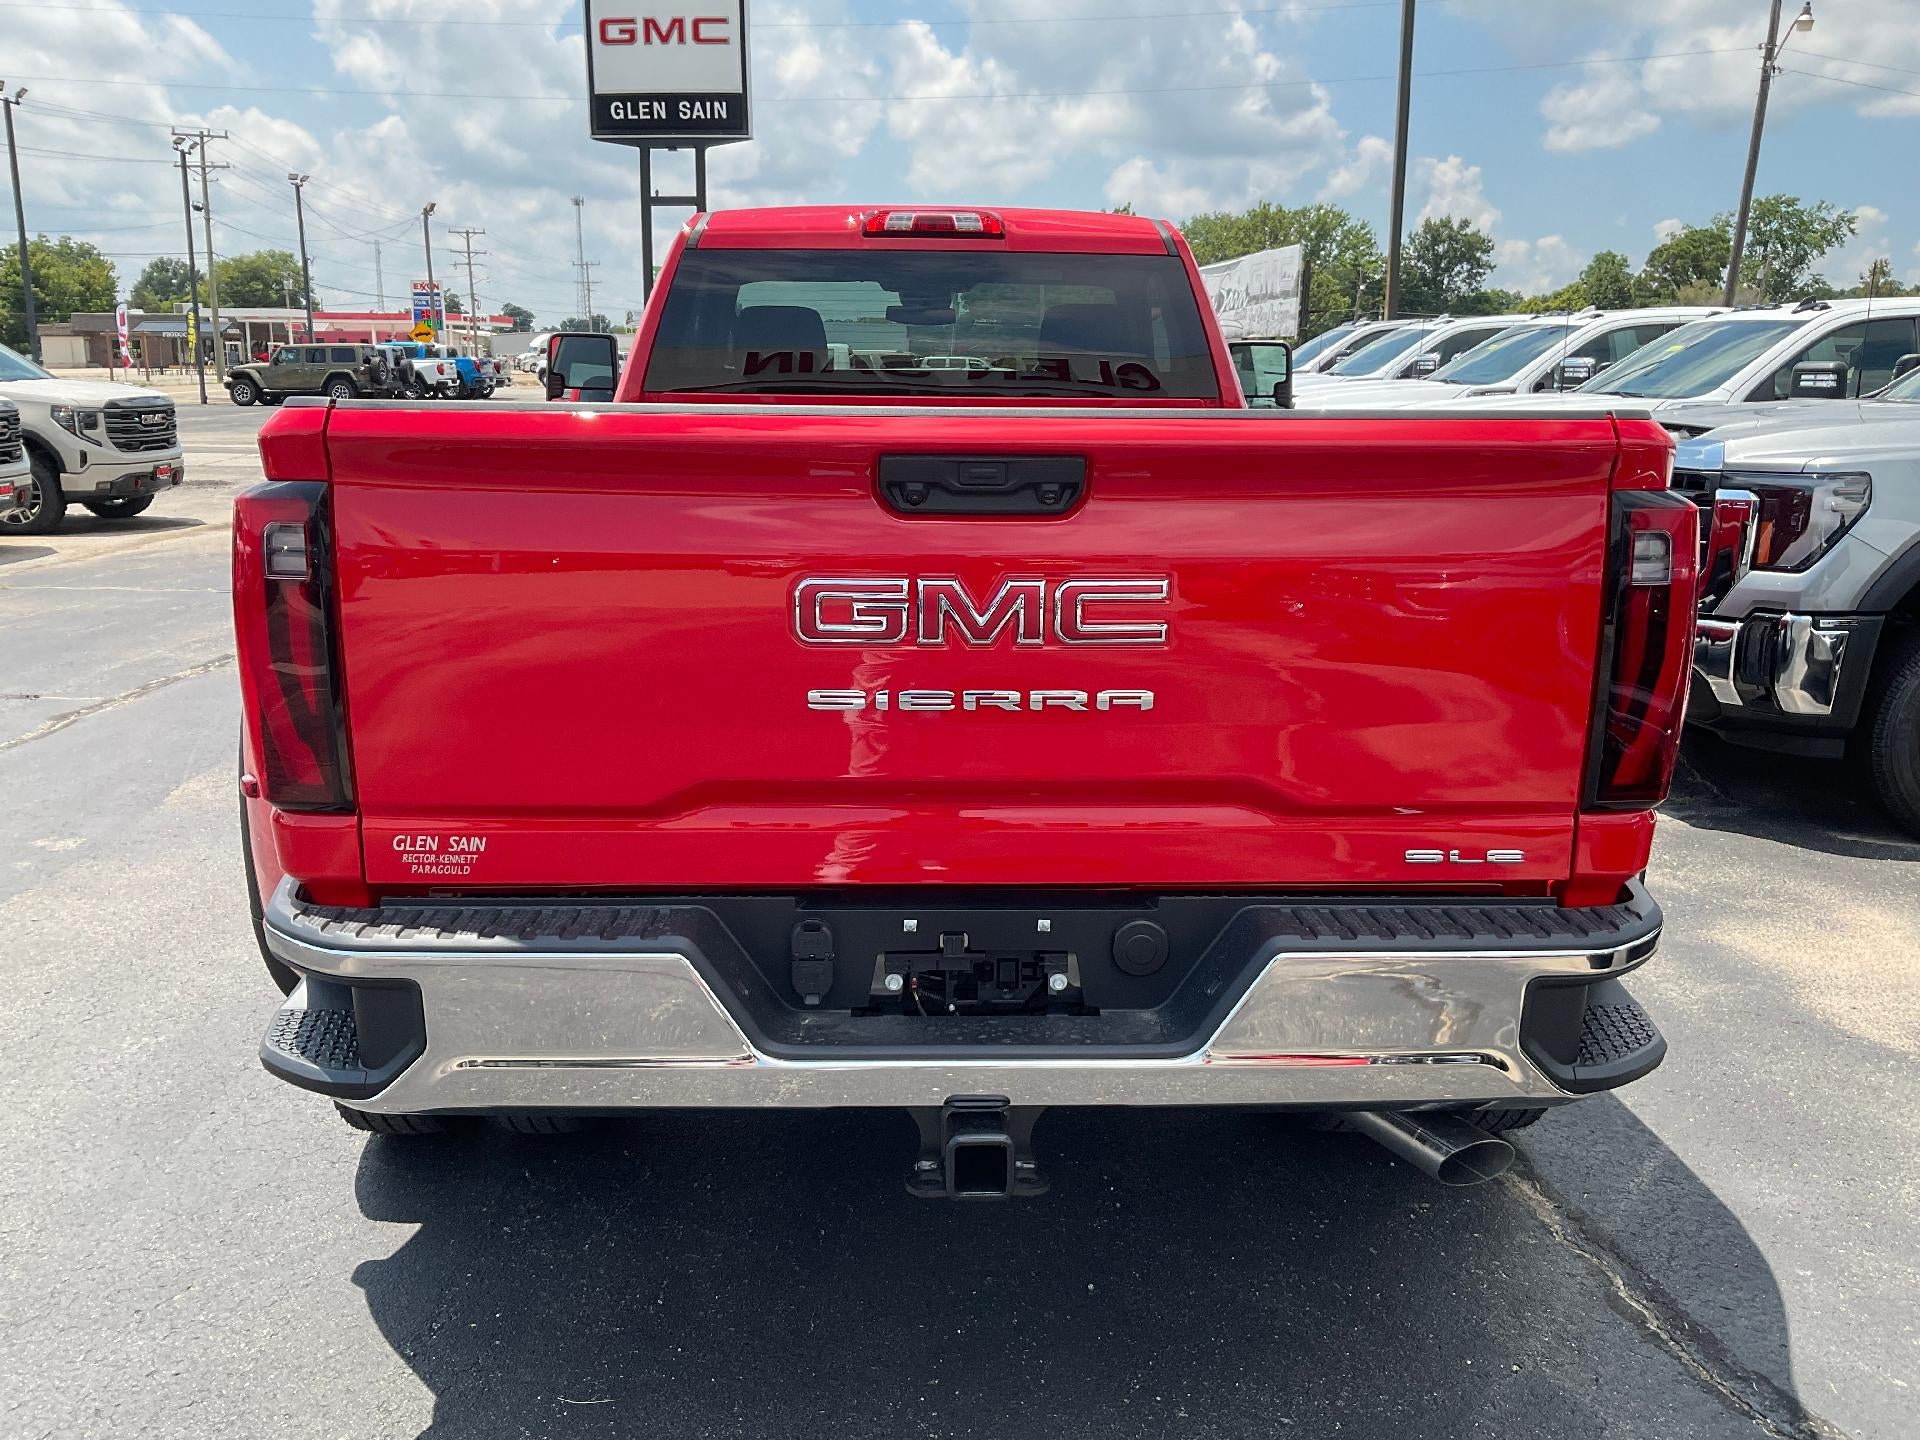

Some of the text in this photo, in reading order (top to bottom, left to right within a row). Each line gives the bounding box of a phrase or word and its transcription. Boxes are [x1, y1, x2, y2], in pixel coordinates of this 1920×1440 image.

[599, 16, 730, 46] GMC
[610, 101, 728, 120] GLEN SAIN
[794, 577, 1169, 646] GMC
[807, 689, 1155, 711] SIERRA
[392, 835, 487, 852] GLEN SAIN
[402, 853, 479, 864] RECTOR-KENNETT
[1405, 849, 1525, 863] SLE
[411, 864, 471, 875] PARAGOULD
